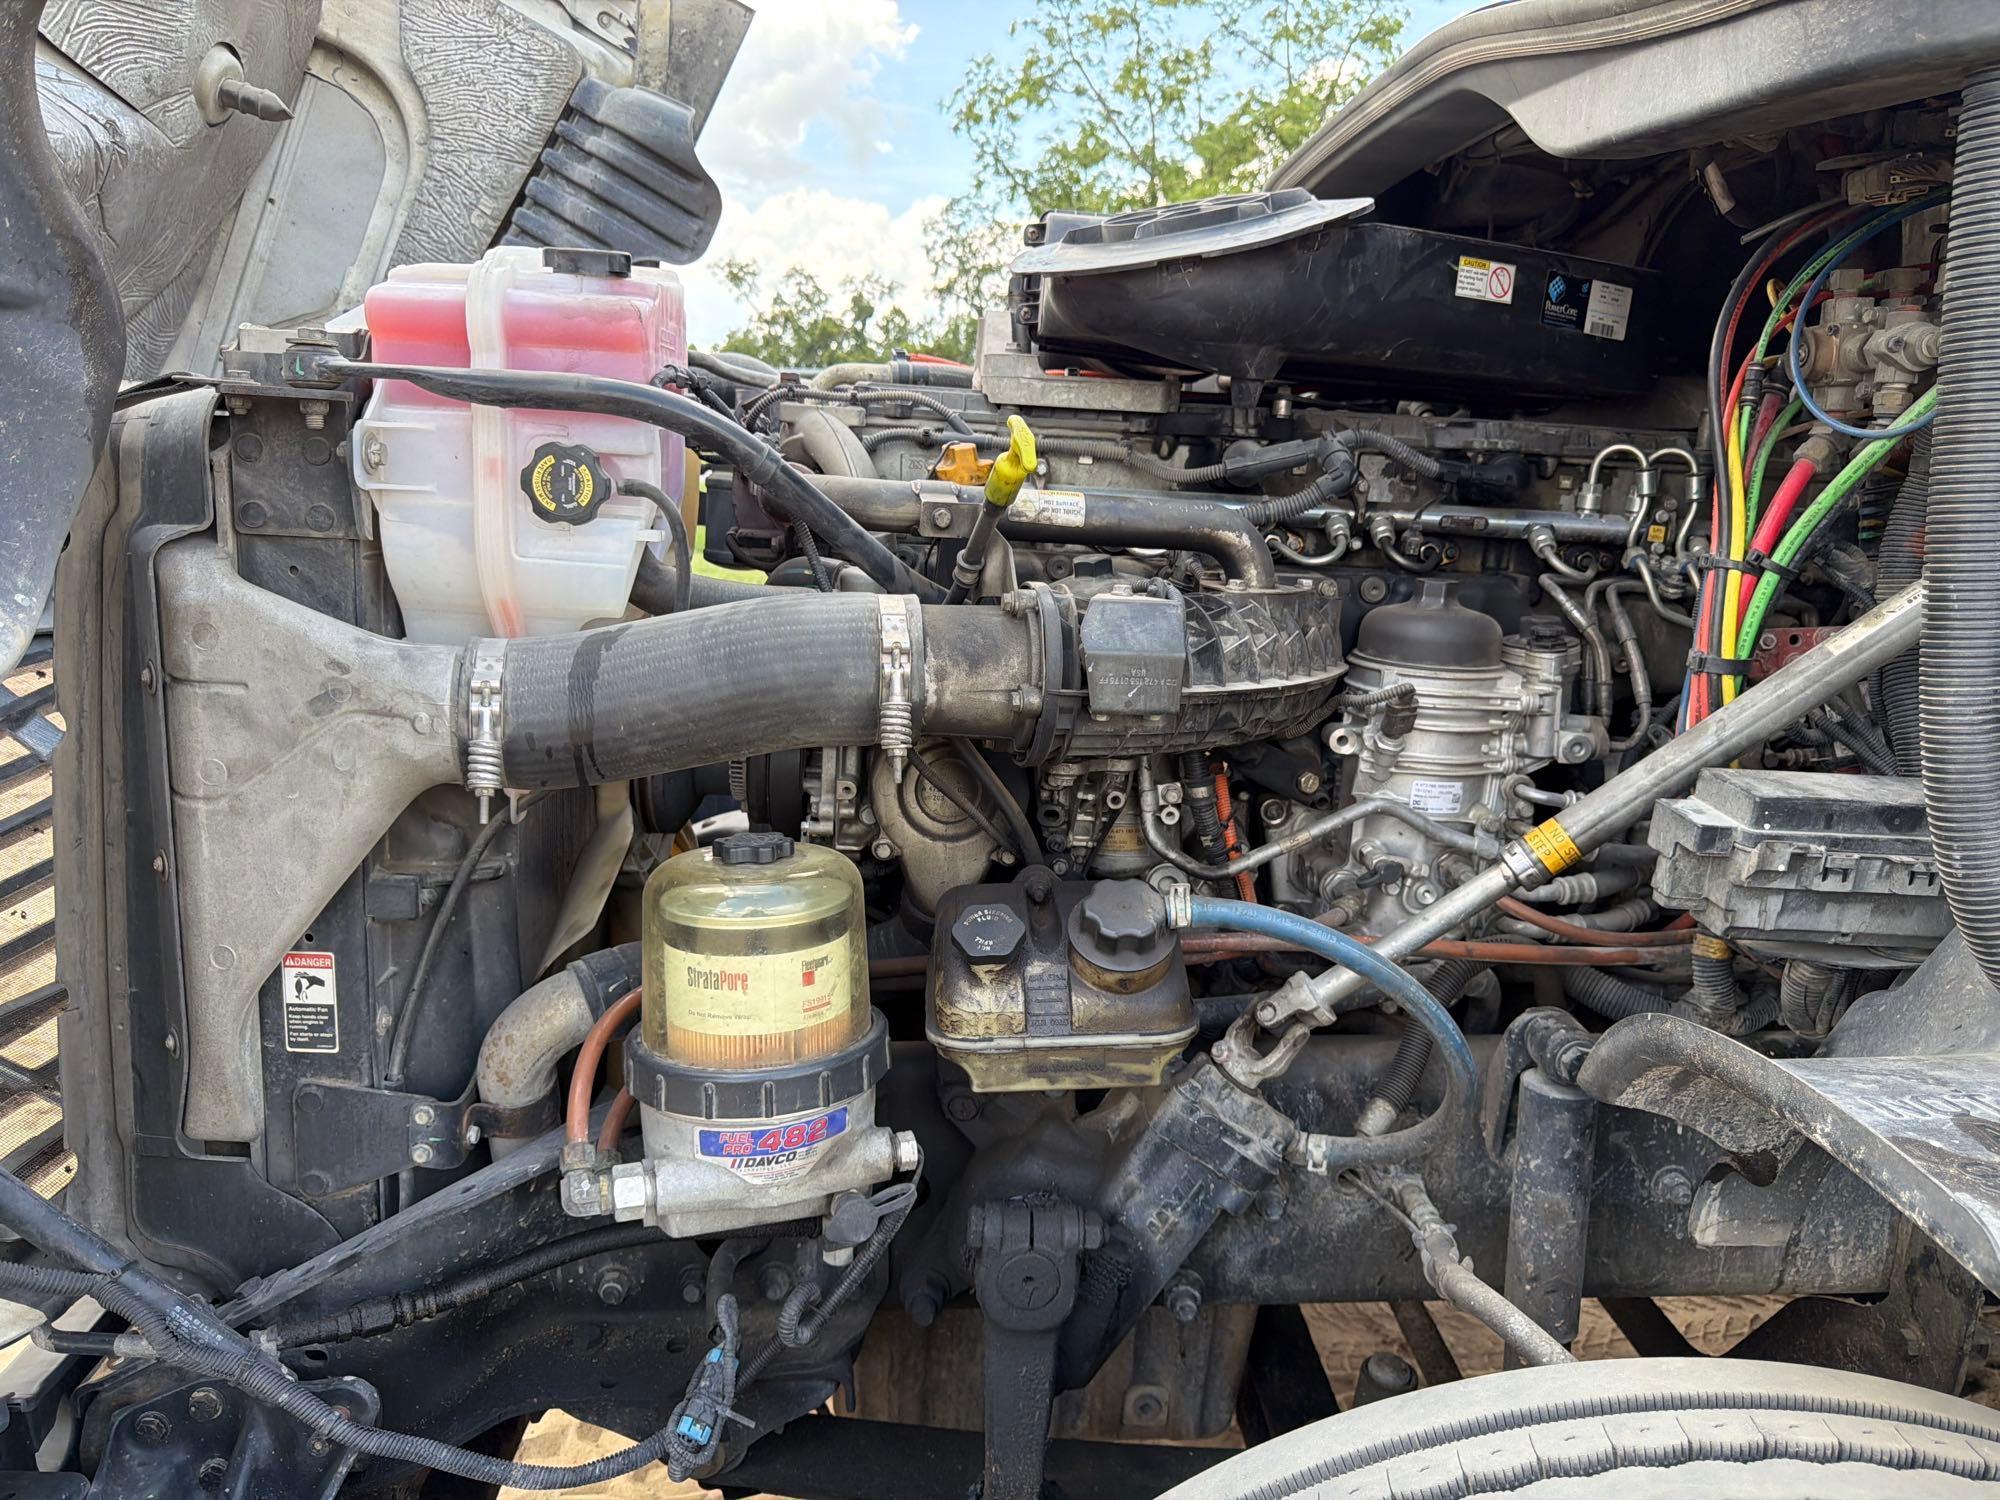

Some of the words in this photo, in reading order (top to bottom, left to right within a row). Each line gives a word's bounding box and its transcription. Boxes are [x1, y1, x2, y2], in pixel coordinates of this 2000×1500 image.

[1463, 259, 1487, 269] CAUTION
[1545, 299, 1579, 317] PowerCore
[581, 472, 593, 505] CAUTION
[1550, 828, 1566, 843] NO
[1529, 834, 1552, 857] STEP
[976, 915, 1000, 923] FLUID
[294, 957, 332, 967] DANGER
[687, 966, 749, 992] StrataPore
[707, 1012, 733, 1020] Remove
[719, 1131, 754, 1144] FUEL
[757, 1116, 828, 1152] 482
[723, 1143, 753, 1155] PRO
[744, 1151, 797, 1168] DAVCO
